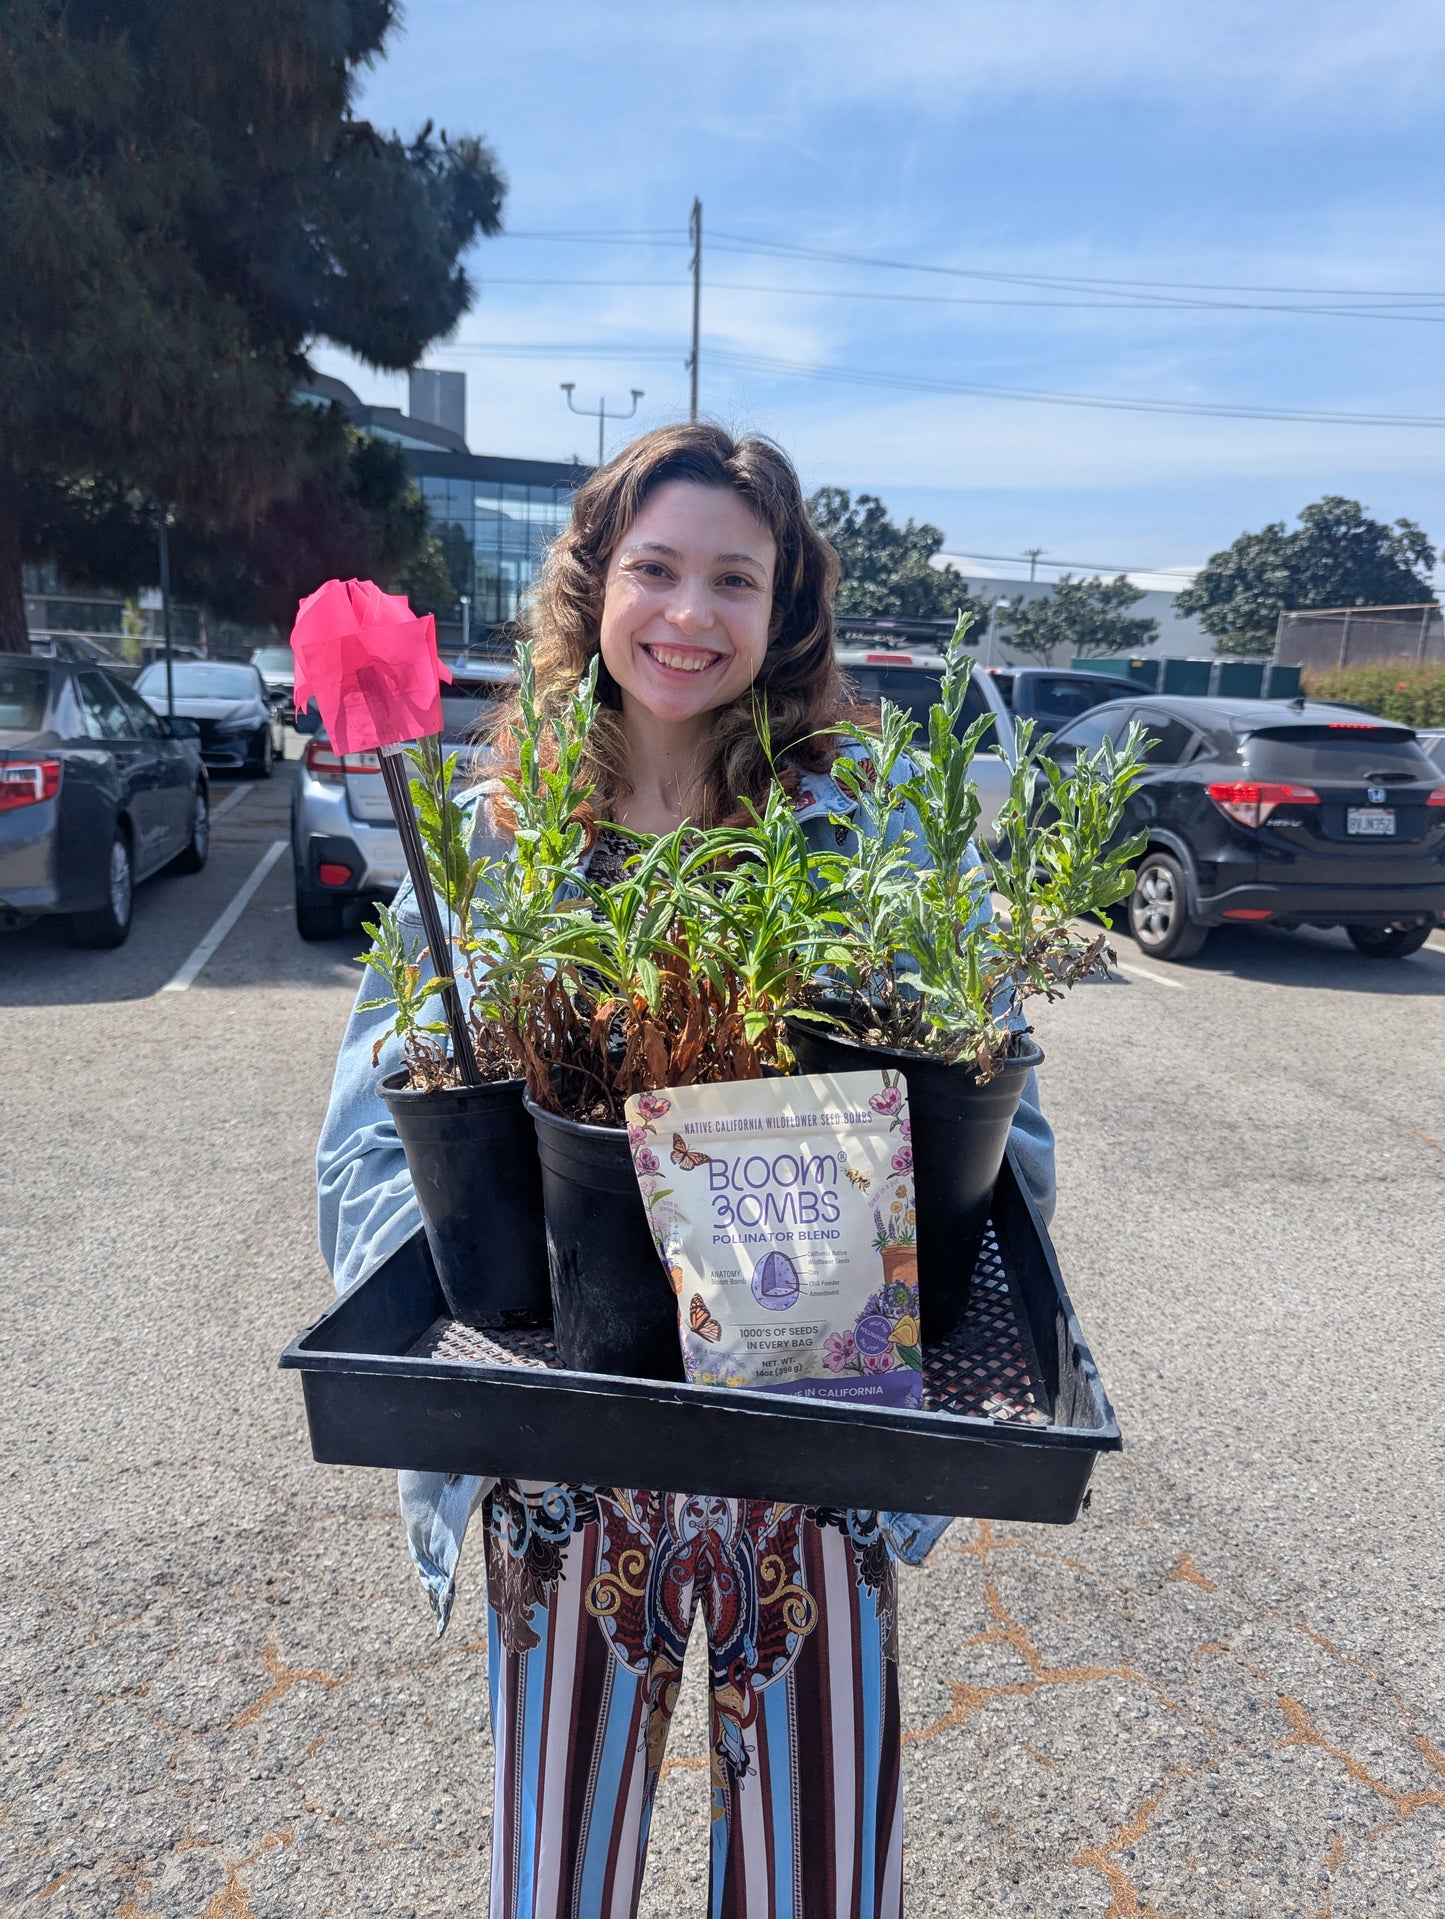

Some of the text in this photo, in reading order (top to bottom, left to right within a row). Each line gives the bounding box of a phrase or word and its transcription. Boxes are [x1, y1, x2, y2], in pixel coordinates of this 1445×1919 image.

[684, 1111, 873, 1134] NATIVE CALIFORNIA WILDFLOWER SEED BOMBS
[712, 1229, 841, 1245] POLLINATOR BLEND
[711, 1270, 741, 1278] ANATOMY
[740, 1325, 819, 1339] 1000'S OF SEEDS
[747, 1338, 813, 1350] IN EVERY BAG
[762, 1357, 796, 1368] NET. WT.
[805, 1388, 816, 1397] IN
[818, 1385, 883, 1398] CALIFORNIA
